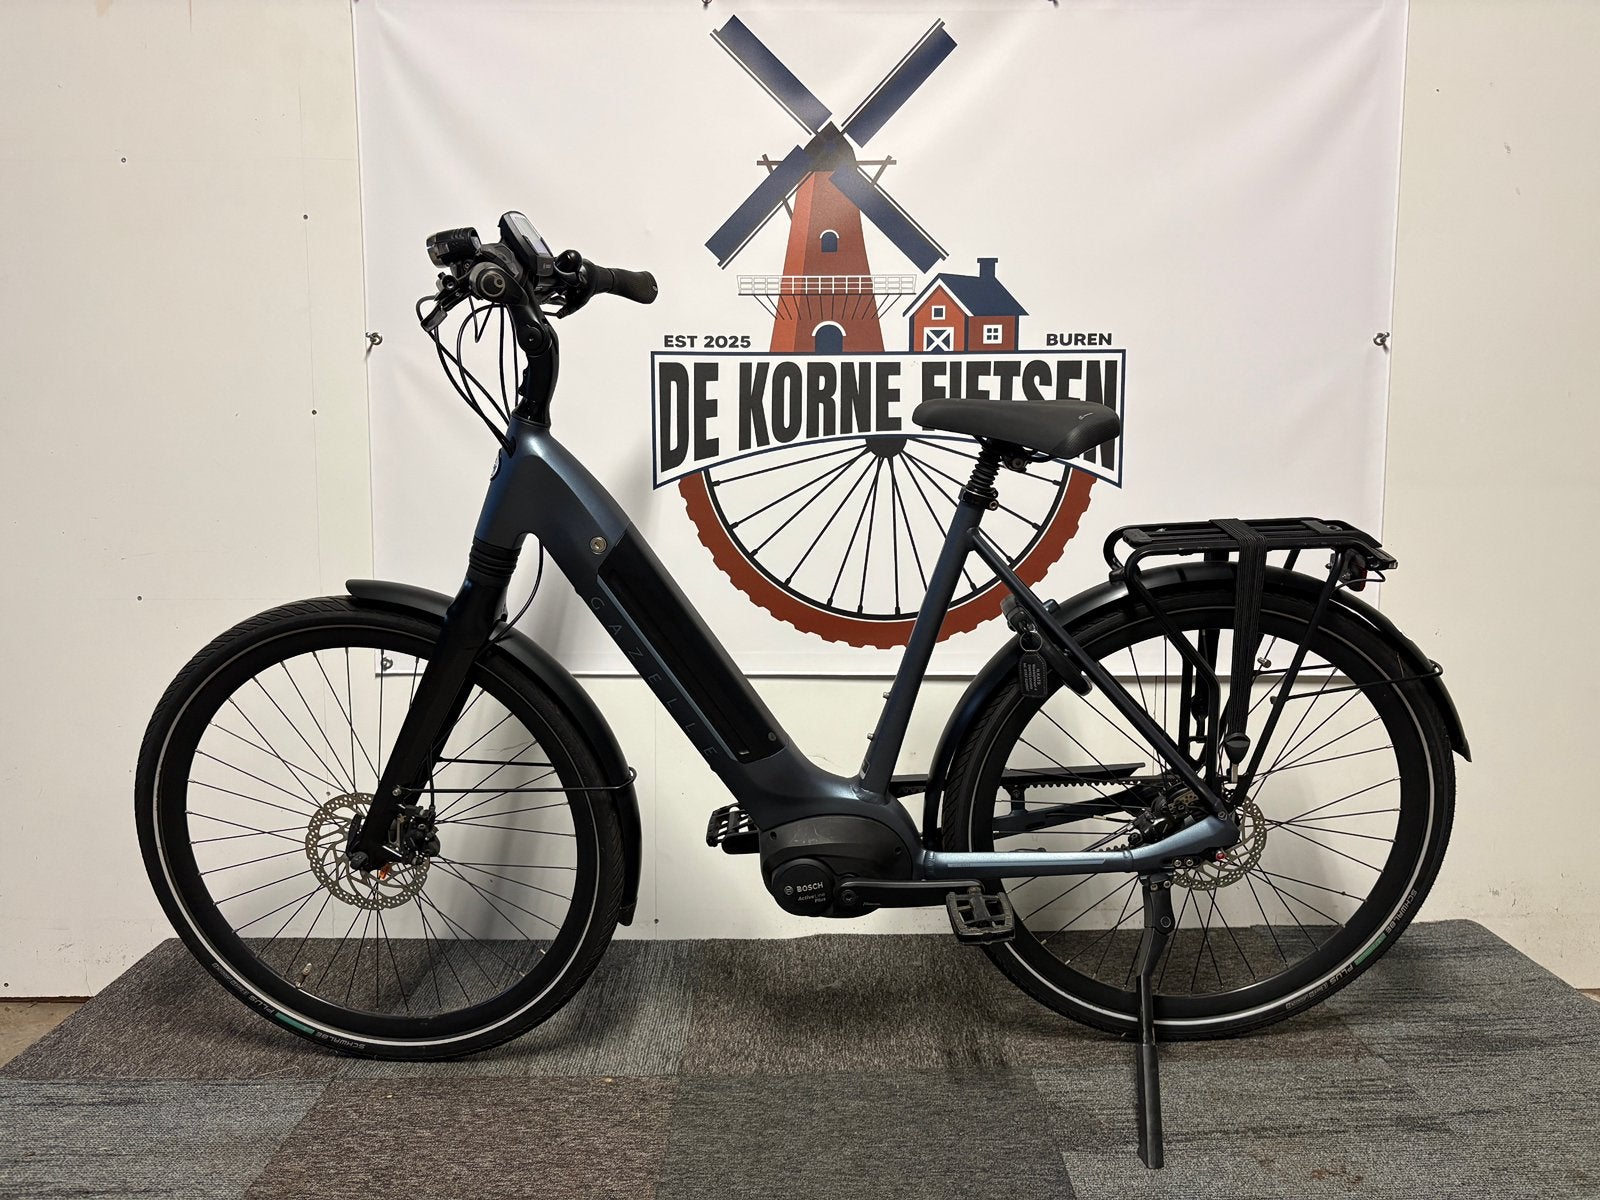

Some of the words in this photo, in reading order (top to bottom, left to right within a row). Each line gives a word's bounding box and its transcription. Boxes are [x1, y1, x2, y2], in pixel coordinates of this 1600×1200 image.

[664, 335, 698, 348] EST
[703, 335, 751, 348] 2025
[1046, 333, 1112, 346] BUREN
[658, 361, 719, 472] DE
[738, 361, 902, 451] KORNE
[590, 596, 718, 757] GAZELLE
[796, 881, 824, 893] BOSCH
[1385, 889, 1417, 934] SCHWALBE
[1329, 964, 1354, 985] PLUS
[249, 995, 275, 1014] PLUS
[315, 1031, 366, 1050] SCHWALBE
